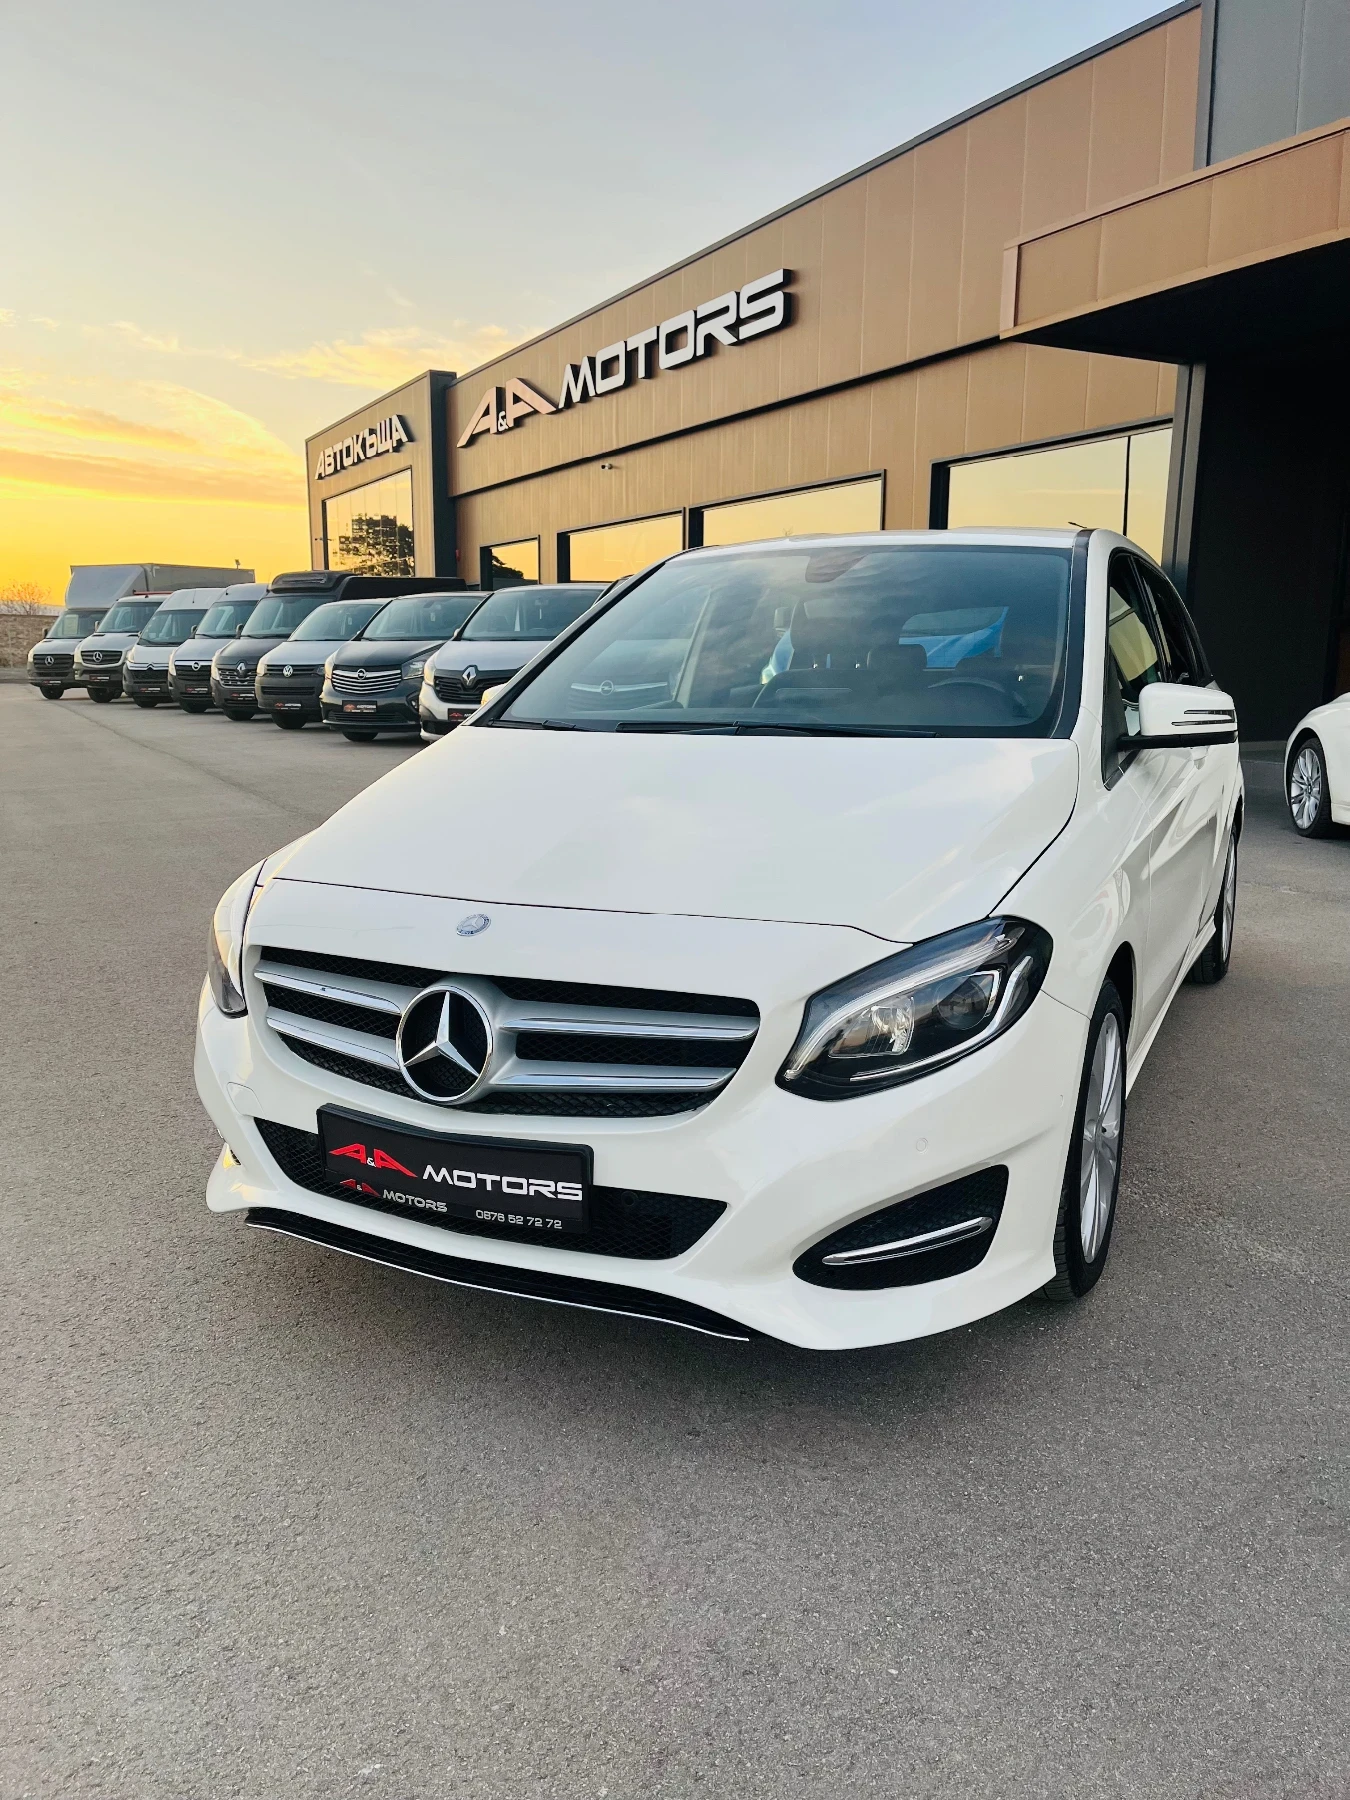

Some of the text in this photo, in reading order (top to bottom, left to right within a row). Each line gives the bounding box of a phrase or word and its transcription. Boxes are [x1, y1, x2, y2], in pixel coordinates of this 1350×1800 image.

[456, 267, 786, 448] A&A MOTORS
[314, 413, 409, 480] АВТОКЪЩА
[328, 1142, 583, 1202] A&A MOTORS
[339, 1178, 448, 1213] A&A MOTORS
[526, 1216, 543, 1227] 72
[545, 1218, 563, 1229] 72
